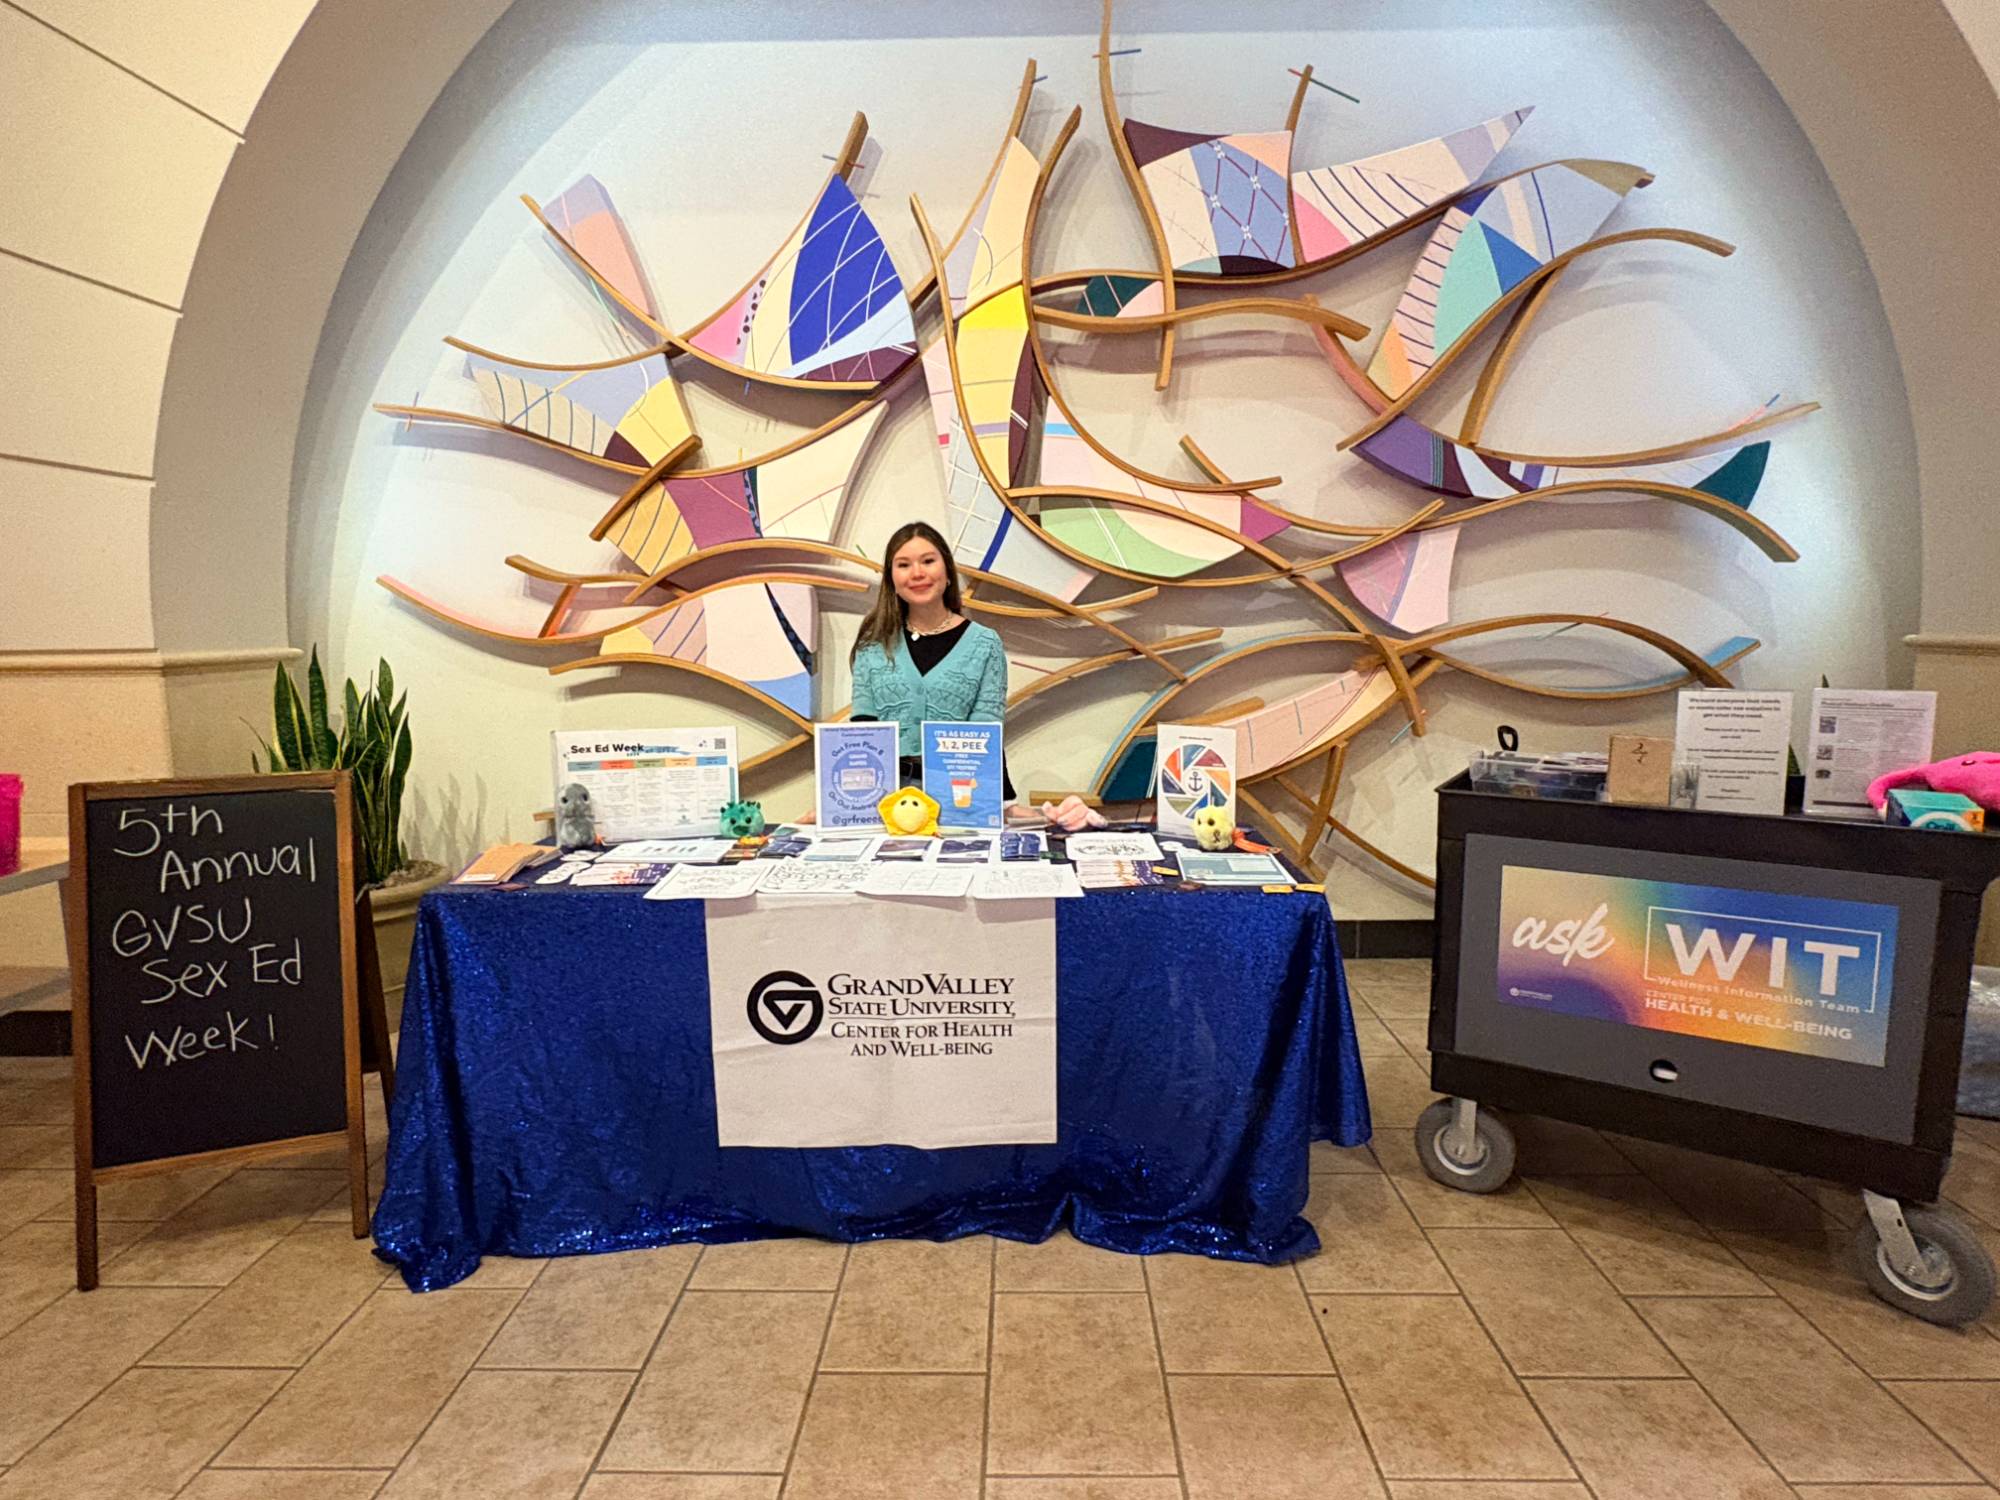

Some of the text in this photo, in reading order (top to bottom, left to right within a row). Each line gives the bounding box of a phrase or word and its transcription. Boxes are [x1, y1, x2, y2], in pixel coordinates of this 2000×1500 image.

[570, 745, 592, 754] Sex
[595, 744, 610, 753] Ed
[612, 743, 644, 752] Week
[962, 741, 982, 750] PEE
[113, 803, 223, 856] 5th
[160, 837, 316, 893] Annual
[112, 897, 252, 957] GVSU
[1512, 903, 1860, 996] ask WIT
[141, 937, 301, 1004] Sex Ed
[827, 973, 1015, 996] GRAND VALLEY
[828, 997, 888, 1016] STATE
[1646, 990, 1687, 1001] CENTER
[1657, 976, 1720, 993] Wellness
[1820, 1000, 1860, 1014] Team
[831, 1021, 1013, 1038] CENTER FOR HEALTH
[1645, 998, 1853, 1040] HEALTH & WELL-BEING
[850, 1040, 993, 1057] AND WELL-BEING
